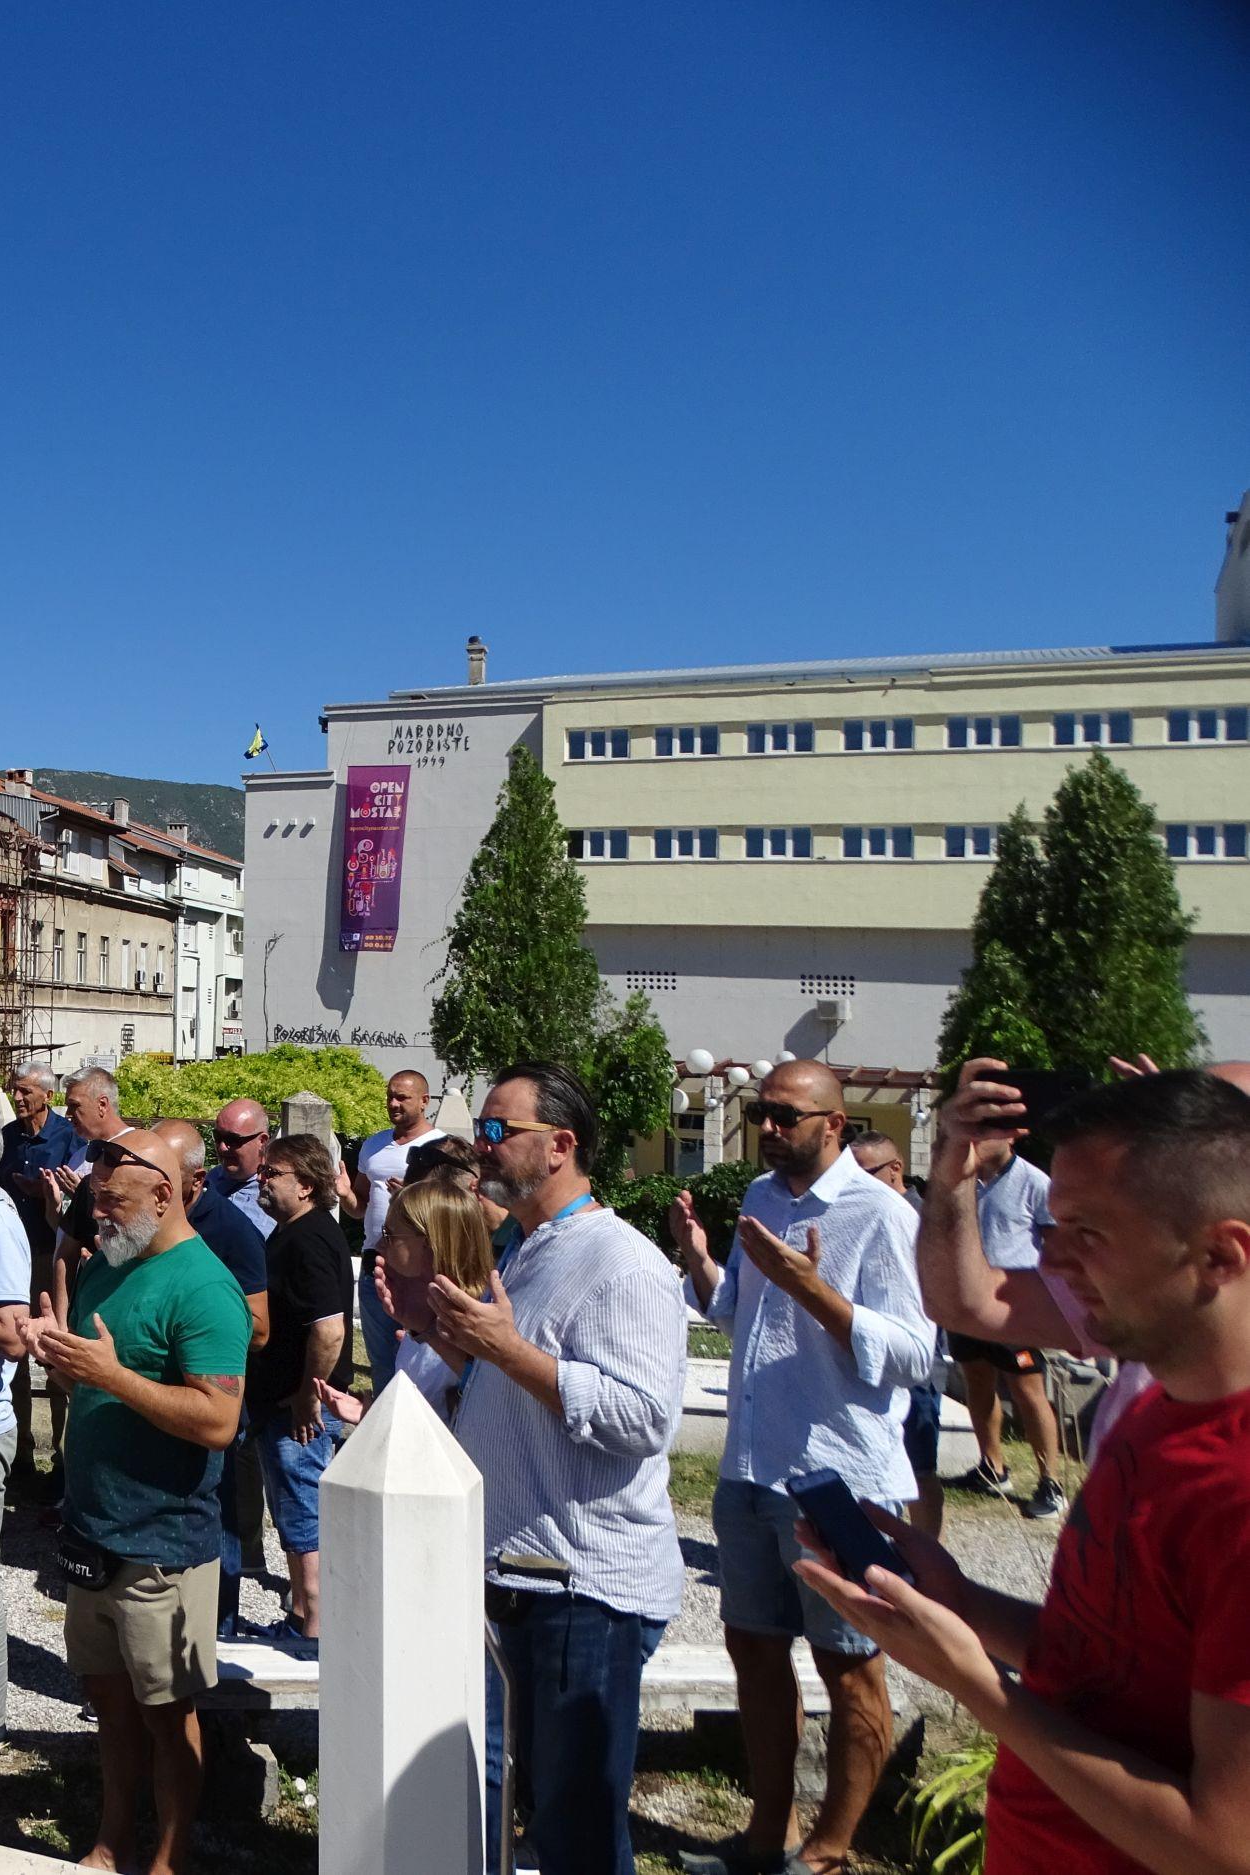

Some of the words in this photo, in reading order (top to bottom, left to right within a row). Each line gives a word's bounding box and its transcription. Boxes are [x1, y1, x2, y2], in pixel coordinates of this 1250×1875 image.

[394, 722, 464, 739] NARODNO
[416, 755, 445, 768] 1949
[370, 781, 404, 793] OPEN
[374, 794, 403, 806] CITY
[350, 806, 402, 819] MOSTAR
